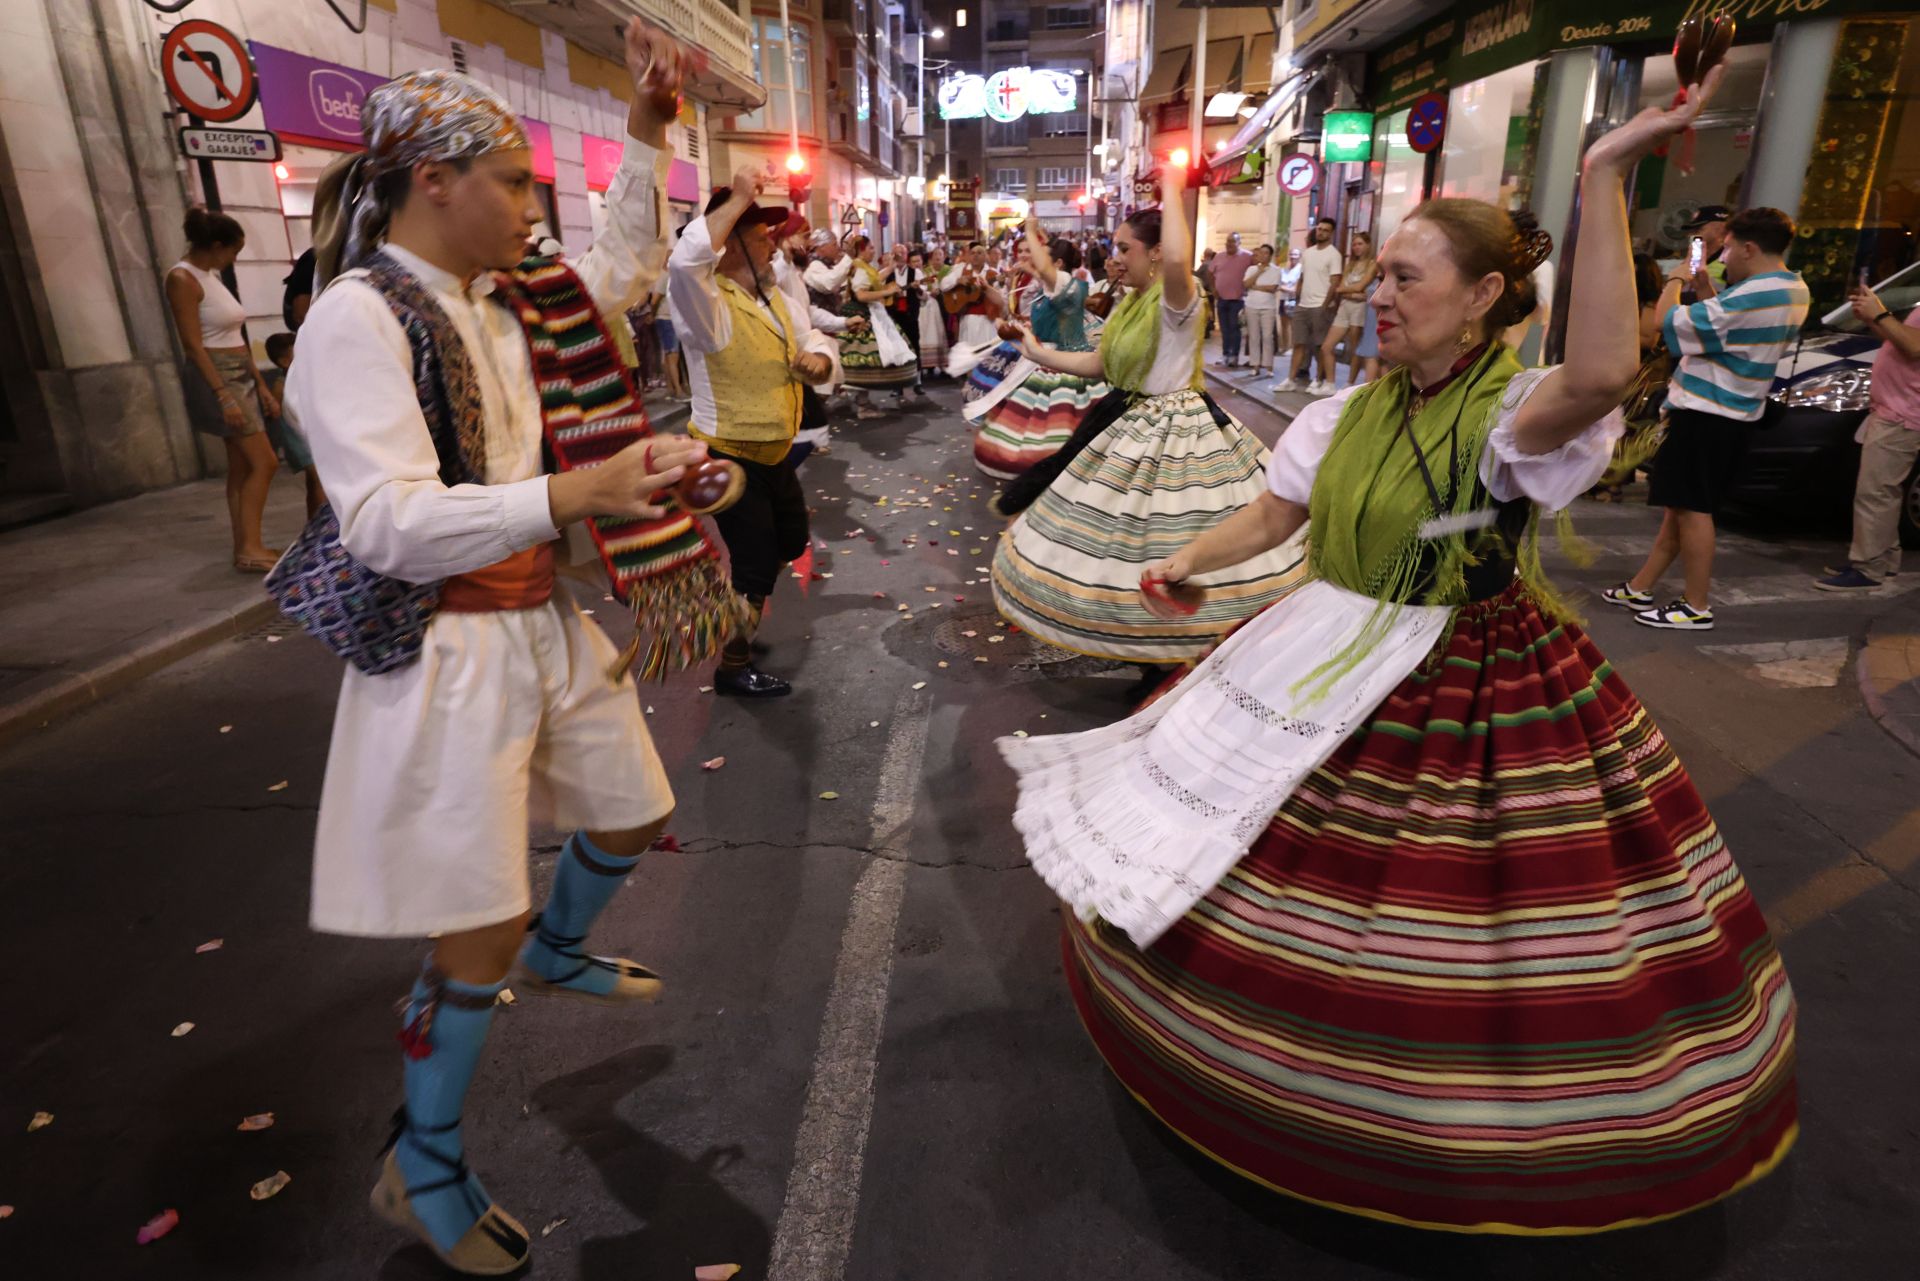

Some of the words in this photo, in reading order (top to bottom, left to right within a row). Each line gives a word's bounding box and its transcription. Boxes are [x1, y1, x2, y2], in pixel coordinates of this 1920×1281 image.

[1560, 22, 1612, 42] Desde
[1615, 16, 1652, 34] 2014
[204, 132, 255, 144] EXCEPTO
[207, 144, 257, 156] GARAJES
